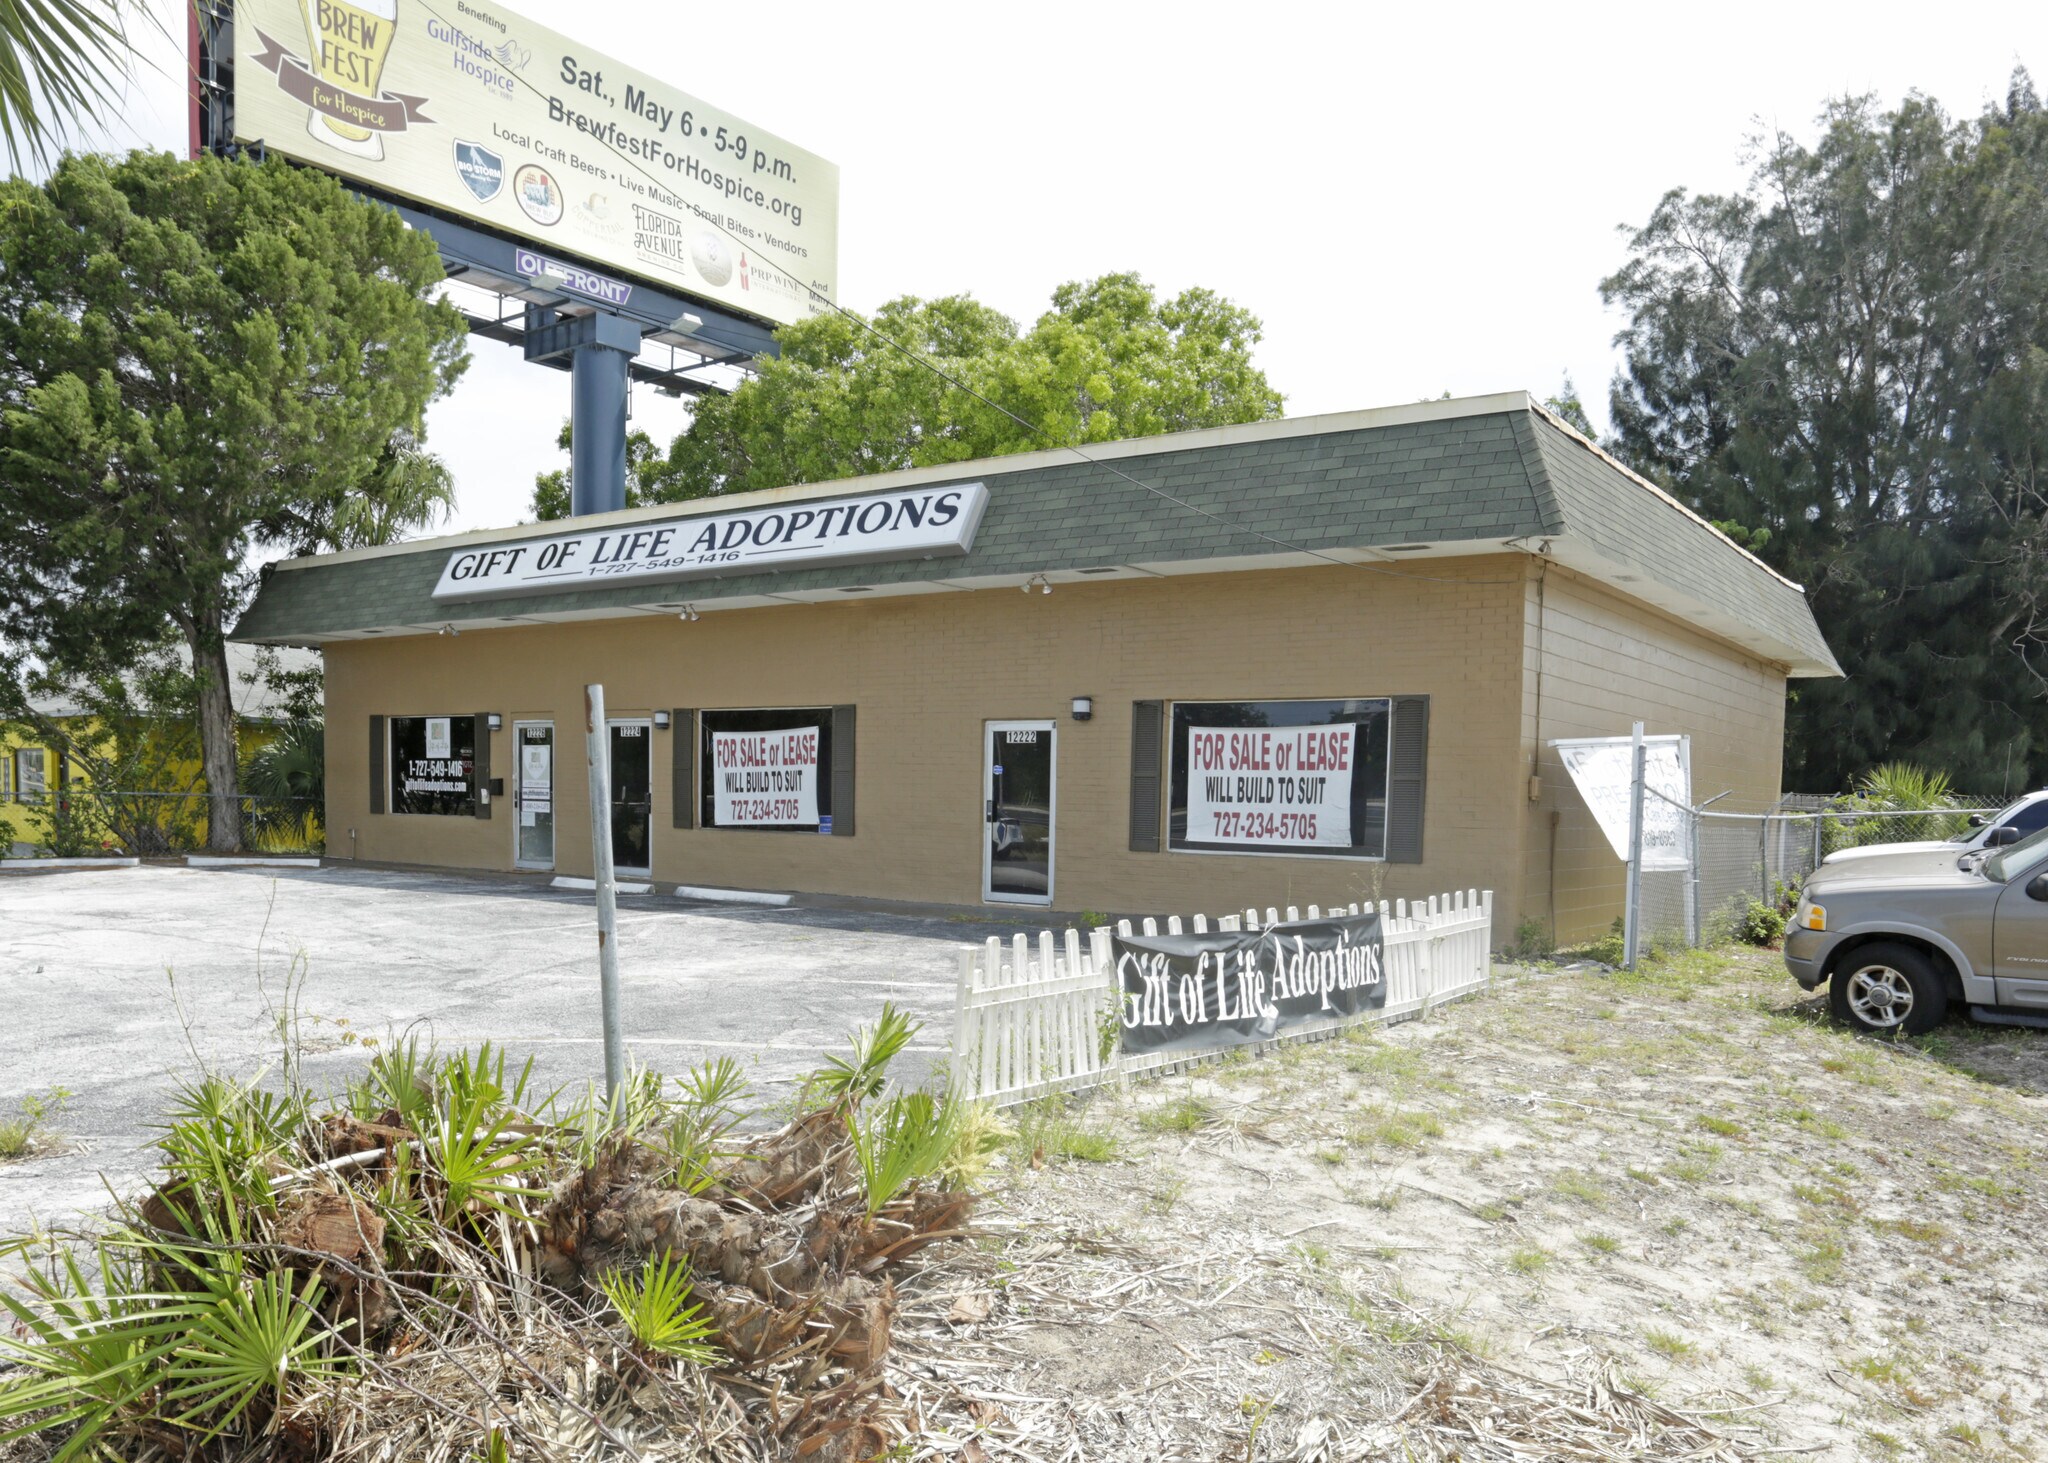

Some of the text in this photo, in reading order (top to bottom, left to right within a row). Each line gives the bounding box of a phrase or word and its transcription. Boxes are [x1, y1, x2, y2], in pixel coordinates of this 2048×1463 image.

[316, 0, 378, 50] BREW
[457, 0, 507, 34] Benefiting
[427, 18, 493, 63] Gulfside
[321, 39, 374, 88] FEST
[453, 51, 515, 93] Hospice
[313, 86, 386, 127] for Hospice
[560, 56, 797, 183] Sat., May 6 5-9 p.m.
[457, 160, 501, 179] BIG STORM
[549, 96, 802, 226] BrewfestForHospice.org
[493, 122, 808, 258] Local Craft Beers Live Music Small Bites Vendors
[632, 203, 682, 238] FLORIDA
[634, 232, 684, 260] AVENUE
[751, 266, 801, 293] PRP WINE
[811, 280, 828, 292] And
[450, 491, 962, 582] GIFT OF LIFE ADOPTIONS
[588, 550, 740, 577] 1-727-549-1416
[621, 726, 640, 737] 12224
[1007, 731, 1036, 743] 12222
[716, 734, 816, 768] FOR SALE or LEASE
[1194, 732, 1350, 771] FOR SALE or LEASE
[409, 760, 463, 777] 1-727-549-1416
[724, 770, 803, 793] WILL BUILD TO SUIT
[1205, 777, 1326, 805] WILL BUILD TO SUIT
[731, 799, 799, 820] 727-234-5705
[1213, 812, 1317, 840] 727-234-5705
[1116, 928, 1381, 1029] Gift of Life Adoptions
